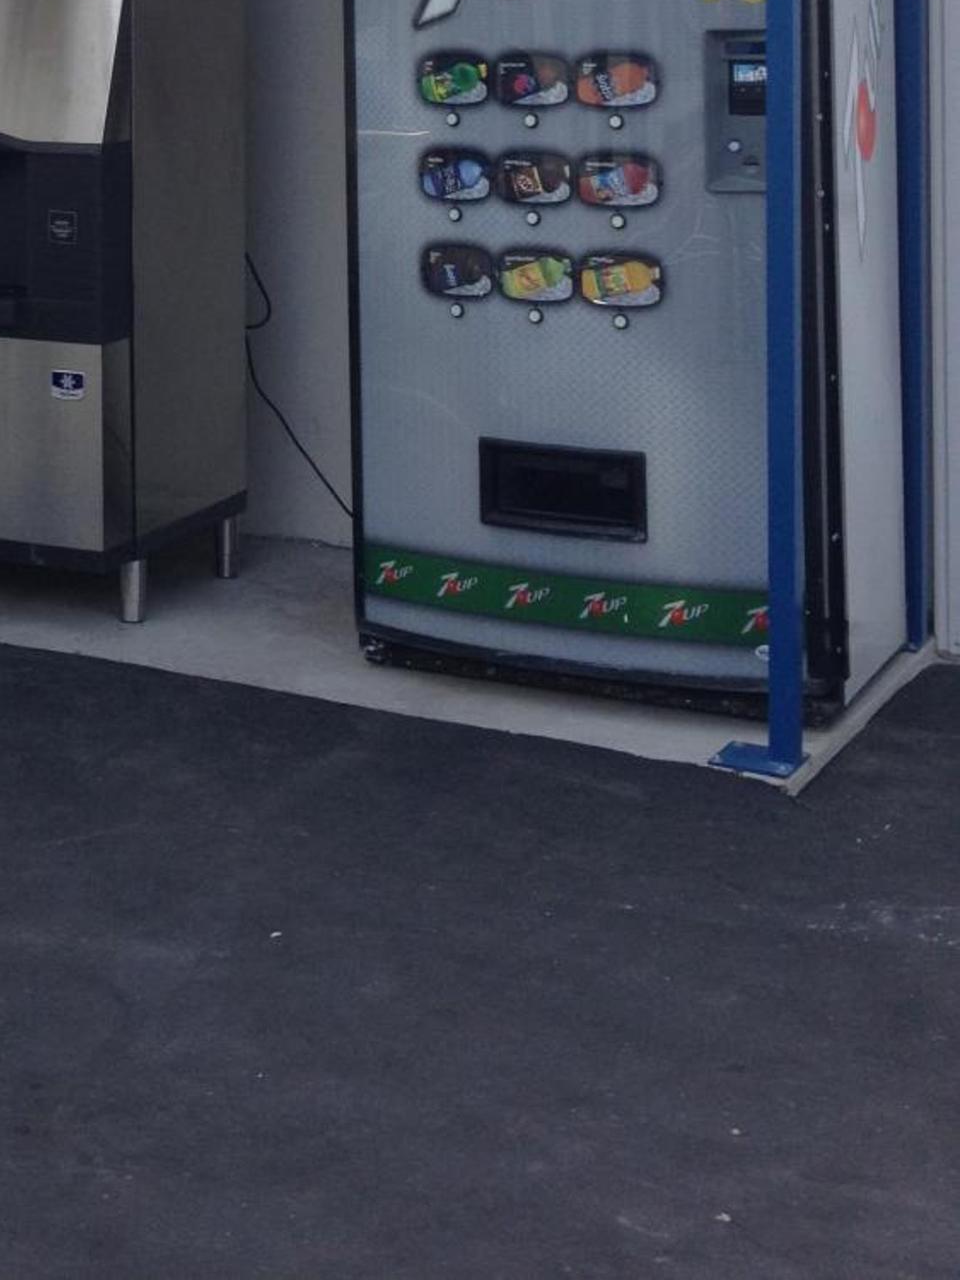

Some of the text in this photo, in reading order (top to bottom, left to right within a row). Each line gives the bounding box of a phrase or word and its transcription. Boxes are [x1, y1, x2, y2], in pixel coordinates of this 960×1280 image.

[376, 560, 413, 584] 7UP
[437, 572, 478, 597] 7UP
[504, 583, 550, 609] 7UP
[579, 592, 627, 618] 7UP
[658, 600, 709, 627] 7UP
